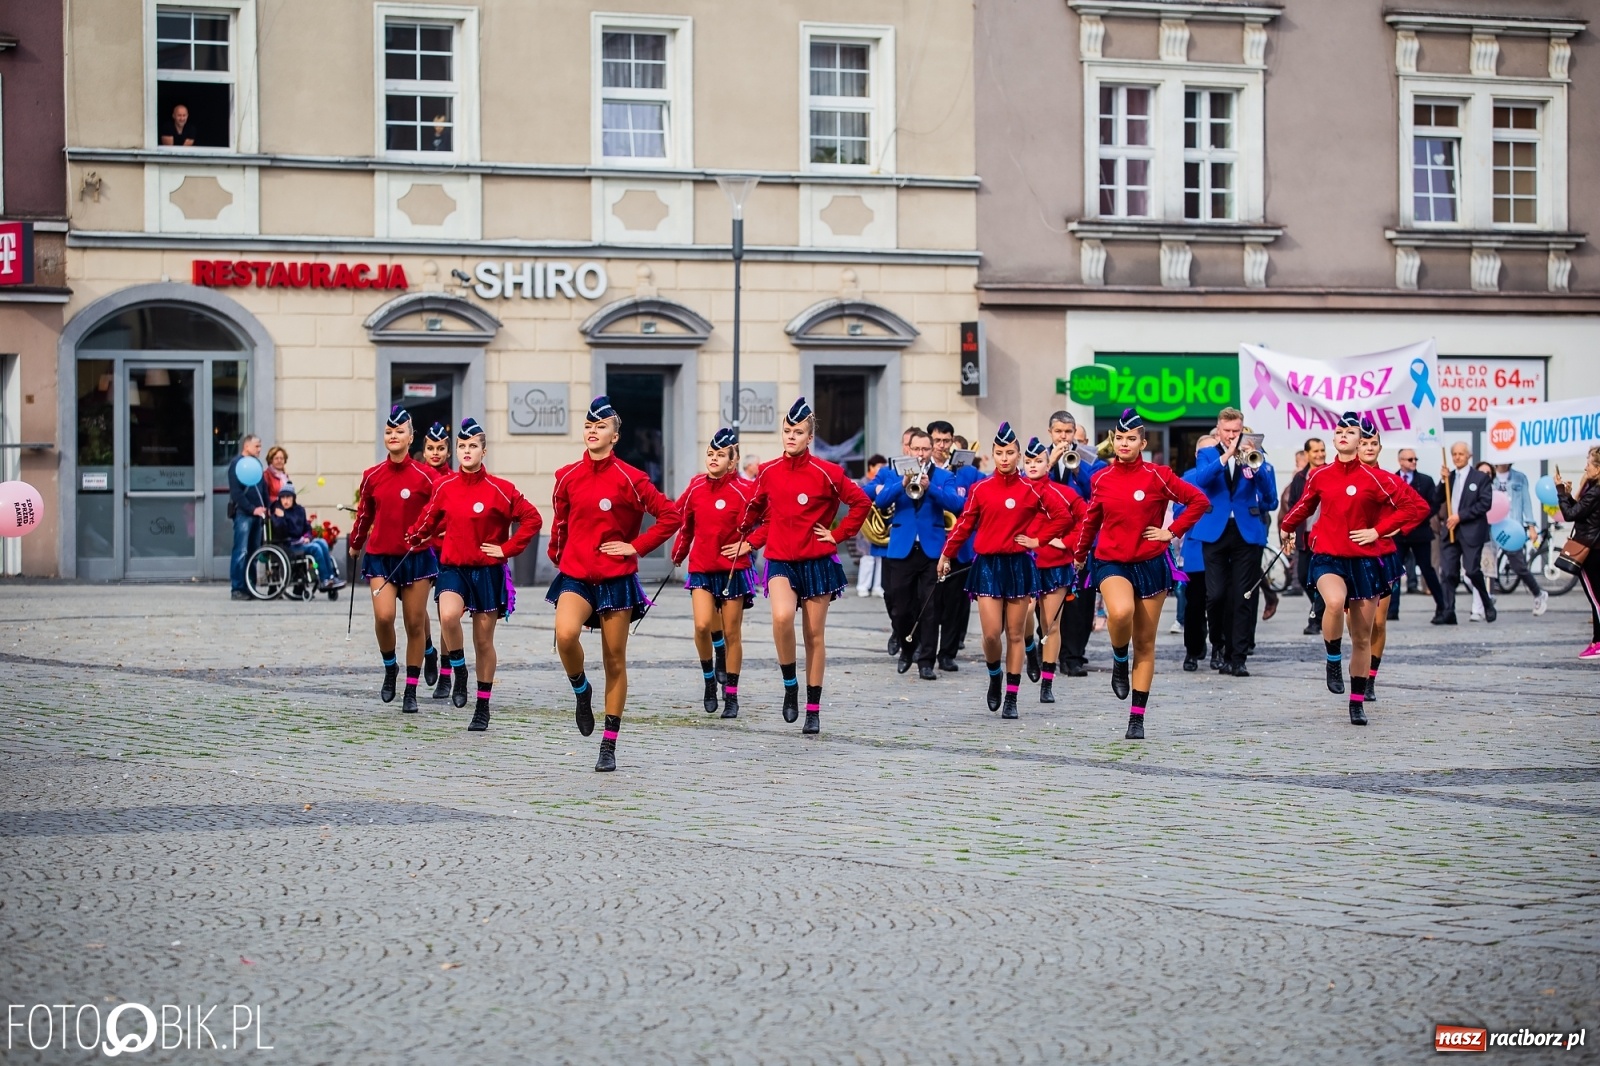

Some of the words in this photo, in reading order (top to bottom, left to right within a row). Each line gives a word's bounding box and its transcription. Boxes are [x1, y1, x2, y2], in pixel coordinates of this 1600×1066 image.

[192, 260, 408, 289] RESTAURACJA
[474, 261, 608, 299] SHIRO
[1468, 365, 1488, 376] DO
[1072, 374, 1107, 393] żabka
[1117, 366, 1231, 404] żabka
[1286, 366, 1393, 401] MARSZ
[1438, 378, 1487, 391] AJĘCIA
[1286, 401, 1412, 432] NADIEI
[1492, 428, 1515, 442] STOP
[14, 502, 22, 527] RAKIEM
[21, 502, 29, 525] PRZED
